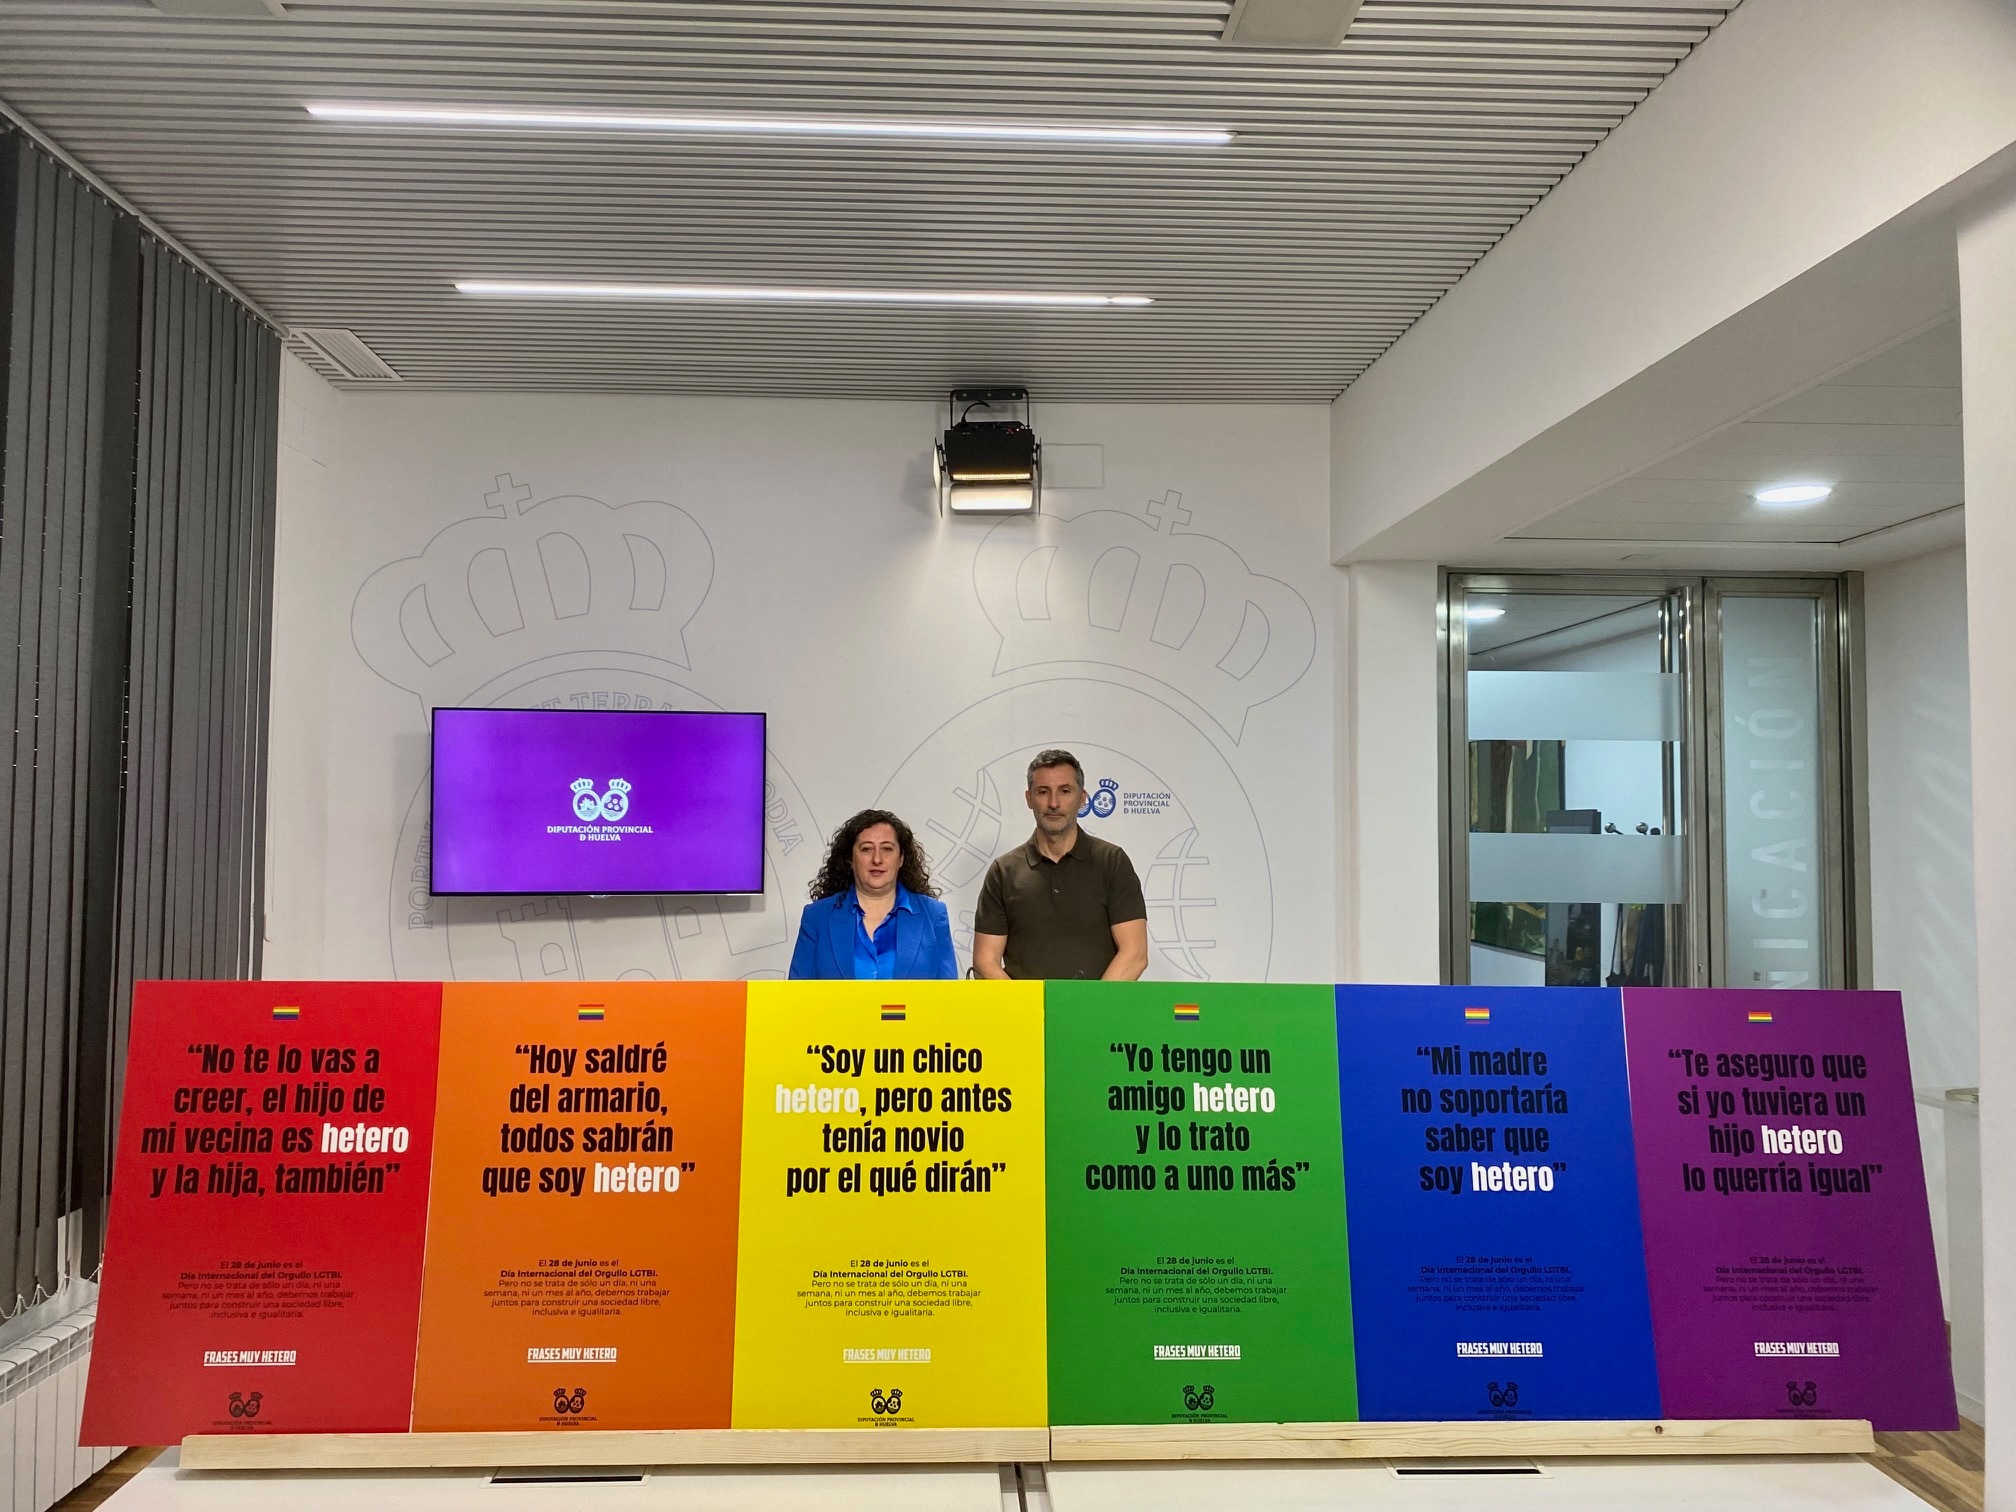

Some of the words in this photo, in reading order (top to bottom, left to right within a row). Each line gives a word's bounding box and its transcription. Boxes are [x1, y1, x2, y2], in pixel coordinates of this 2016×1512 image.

[547, 824, 600, 833] DIPUTACIÓN
[243, 1043, 270, 1074] te
[276, 1043, 302, 1074] lo
[310, 1047, 356, 1074] vas
[364, 1048, 380, 1074] a
[584, 1040, 667, 1074] saldré
[872, 1048, 905, 1074] un
[912, 1042, 983, 1073] chico
[1159, 1043, 1232, 1078] tengo
[1239, 1048, 1271, 1074] un
[1468, 1047, 1547, 1076] madre
[1716, 1053, 1814, 1081] aseguro
[1821, 1054, 1866, 1082] que
[173, 1087, 252, 1116] creer,
[261, 1083, 287, 1114] el
[294, 1081, 346, 1118] hijo
[352, 1083, 385, 1114] de
[508, 1083, 550, 1113] del
[557, 1080, 668, 1116] armario,
[774, 1083, 867, 1117] hetero,
[873, 1086, 933, 1117] pero
[939, 1082, 1012, 1113] antes
[1107, 1079, 1186, 1115] amigo
[1192, 1082, 1276, 1113] hetero
[1400, 1088, 1432, 1113] no
[1439, 1082, 1568, 1117] soportaría
[1678, 1085, 1699, 1114] si
[1706, 1090, 1735, 1118] yo
[1742, 1086, 1828, 1115] tuviera
[1834, 1092, 1866, 1116] un
[140, 1121, 176, 1154] mi
[184, 1120, 274, 1154] vecina
[280, 1126, 314, 1154] es
[320, 1121, 409, 1154] hetero
[500, 1122, 574, 1153] todos
[581, 1119, 674, 1152] sabrán
[821, 1119, 887, 1153] tenía
[893, 1120, 964, 1152] novio
[1135, 1125, 1150, 1154] y
[1156, 1121, 1182, 1151] lo
[1188, 1120, 1251, 1152] trato
[1424, 1122, 1496, 1152] saber
[1503, 1126, 1549, 1156] que
[1708, 1123, 1755, 1157] hijo
[1761, 1125, 1843, 1154] hetero
[149, 1168, 168, 1199] y
[174, 1163, 200, 1194] la
[206, 1160, 265, 1197] hija,
[481, 1166, 531, 1198] que
[537, 1165, 587, 1198] soy
[785, 1167, 830, 1198] por
[837, 1162, 861, 1193] el
[868, 1159, 917, 1196] qué
[1084, 1164, 1157, 1191] como
[1163, 1164, 1179, 1191] a
[1185, 1164, 1234, 1191] uno
[1418, 1164, 1464, 1195] soy
[1682, 1163, 1705, 1191] lo
[1713, 1160, 1802, 1195] querría
[517, 1269, 576, 1277] Internacional
[578, 1269, 592, 1277] del
[594, 1269, 627, 1278] Orgullo
[574, 1258, 597, 1268] junio
[813, 1270, 827, 1278] Día
[830, 1269, 887, 1277] Internacional
[905, 1270, 938, 1278] Orgullo
[850, 1259, 858, 1267] El
[860, 1259, 870, 1267] 28
[872, 1259, 884, 1267] de
[885, 1259, 908, 1269] junio
[921, 1259, 929, 1267] el
[811, 1279, 831, 1287] Pero
[878, 1279, 890, 1287] de
[948, 1289, 980, 1297] trabajar
[804, 1300, 832, 1308] juntos
[854, 1298, 892, 1306] construir
[912, 1298, 950, 1306] sociedad
[845, 1308, 881, 1316] inclusiva
[204, 1351, 238, 1362] FRASES
[239, 1351, 260, 1362] MUY
[261, 1350, 296, 1362] HETERO
[527, 1348, 560, 1359] FRASES
[562, 1348, 581, 1359] MUY
[583, 1347, 616, 1358] HETERO
[843, 1348, 874, 1360] FRASES
[877, 1349, 895, 1360] MUY
[898, 1348, 930, 1359] HETERO
[1154, 1345, 1185, 1356] FRASES
[1187, 1345, 1206, 1356] MUY
[1208, 1345, 1240, 1356] HETERO
[1456, 1342, 1488, 1353] FRASES
[1489, 1342, 1508, 1353] MUY
[1510, 1343, 1542, 1353] HETERO
[1754, 1342, 1785, 1354] FRASES
[1786, 1342, 1805, 1354] MUY
[1806, 1342, 1838, 1354] HETERO
